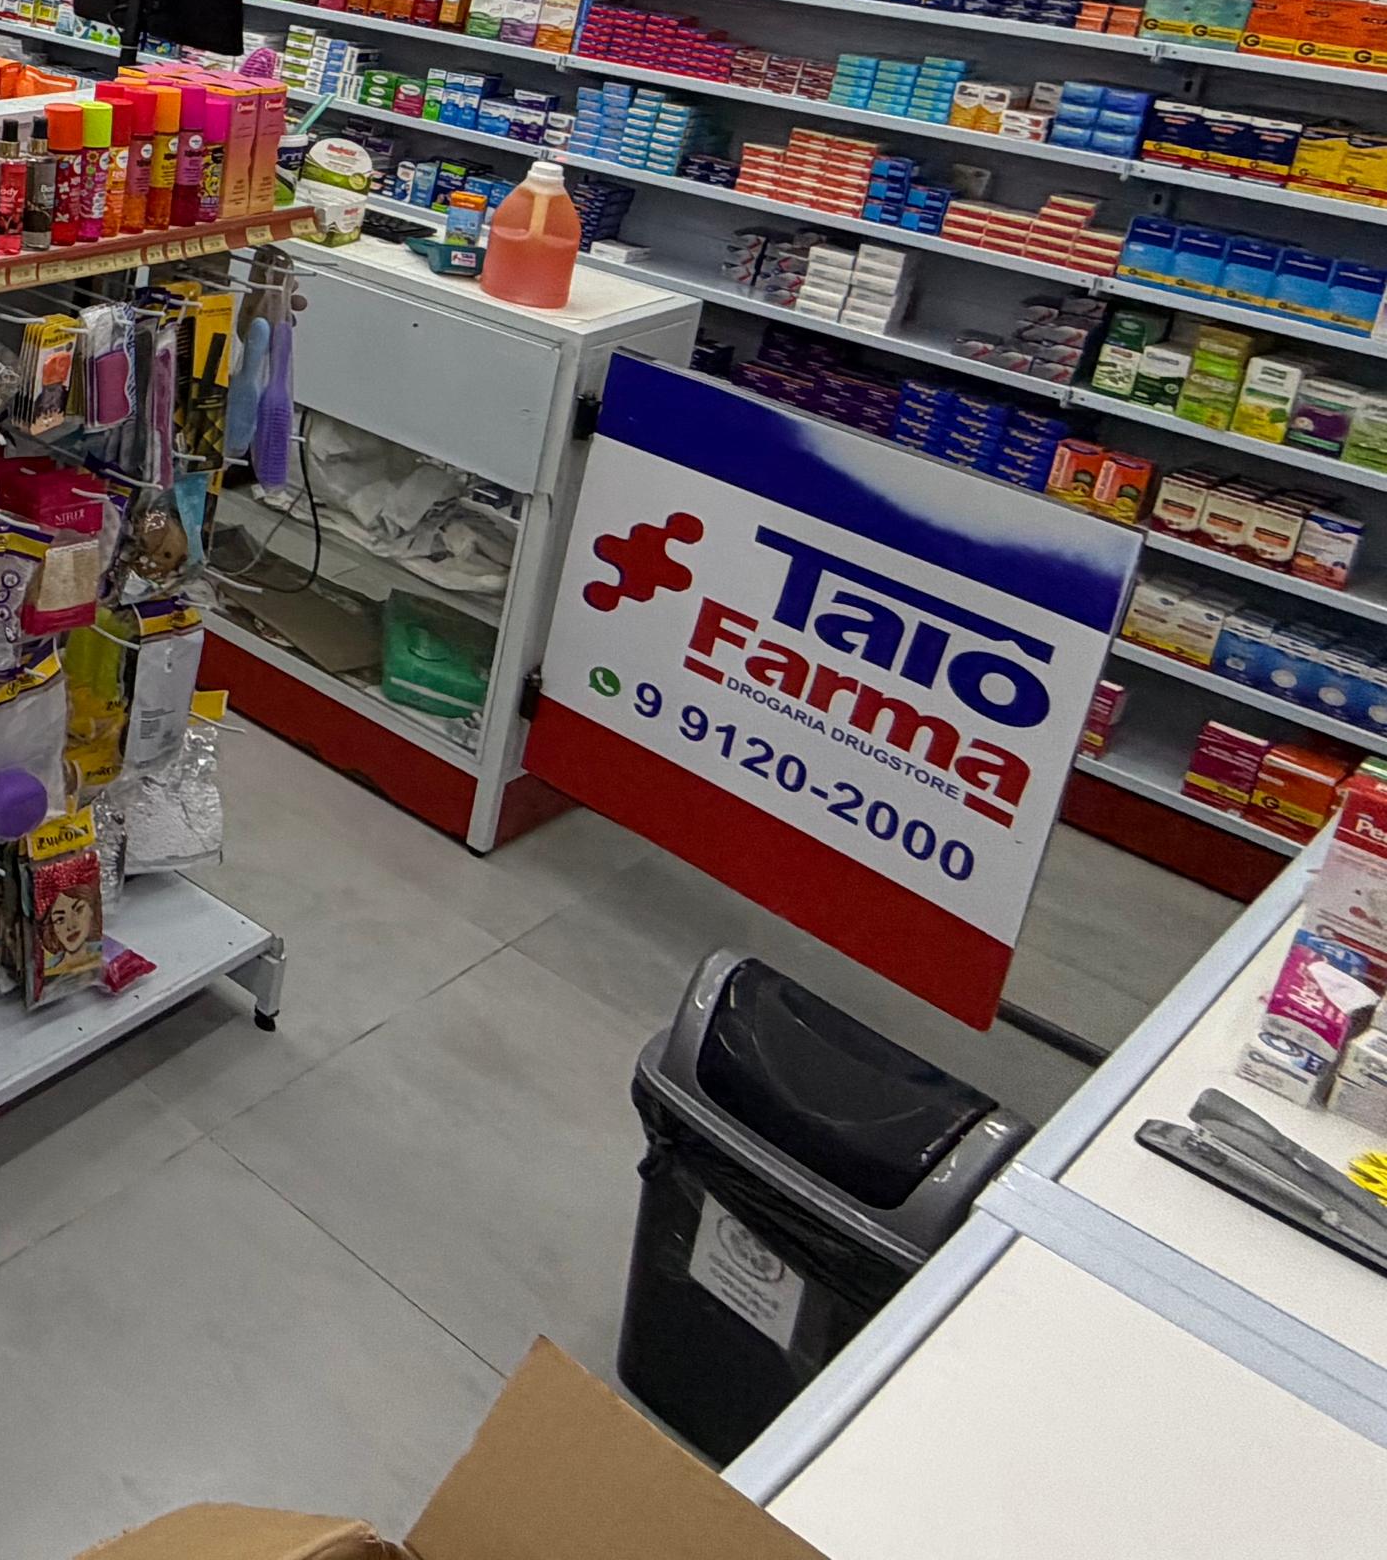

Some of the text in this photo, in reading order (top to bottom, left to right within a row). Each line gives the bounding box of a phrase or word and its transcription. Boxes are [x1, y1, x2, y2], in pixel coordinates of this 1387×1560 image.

[1144, 19, 1159, 30] G
[1192, 25, 1208, 38] G
[1243, 34, 1261, 47] G
[1298, 43, 1316, 56] G
[1354, 50, 1372, 63] G
[0, 187, 18, 199] ody
[754, 525, 1056, 728] Taiô
[685, 596, 1032, 820] Farma
[726, 675, 961, 800] DROGARIA DRUGSTORE
[633, 682, 975, 882] 9 9120-2000
